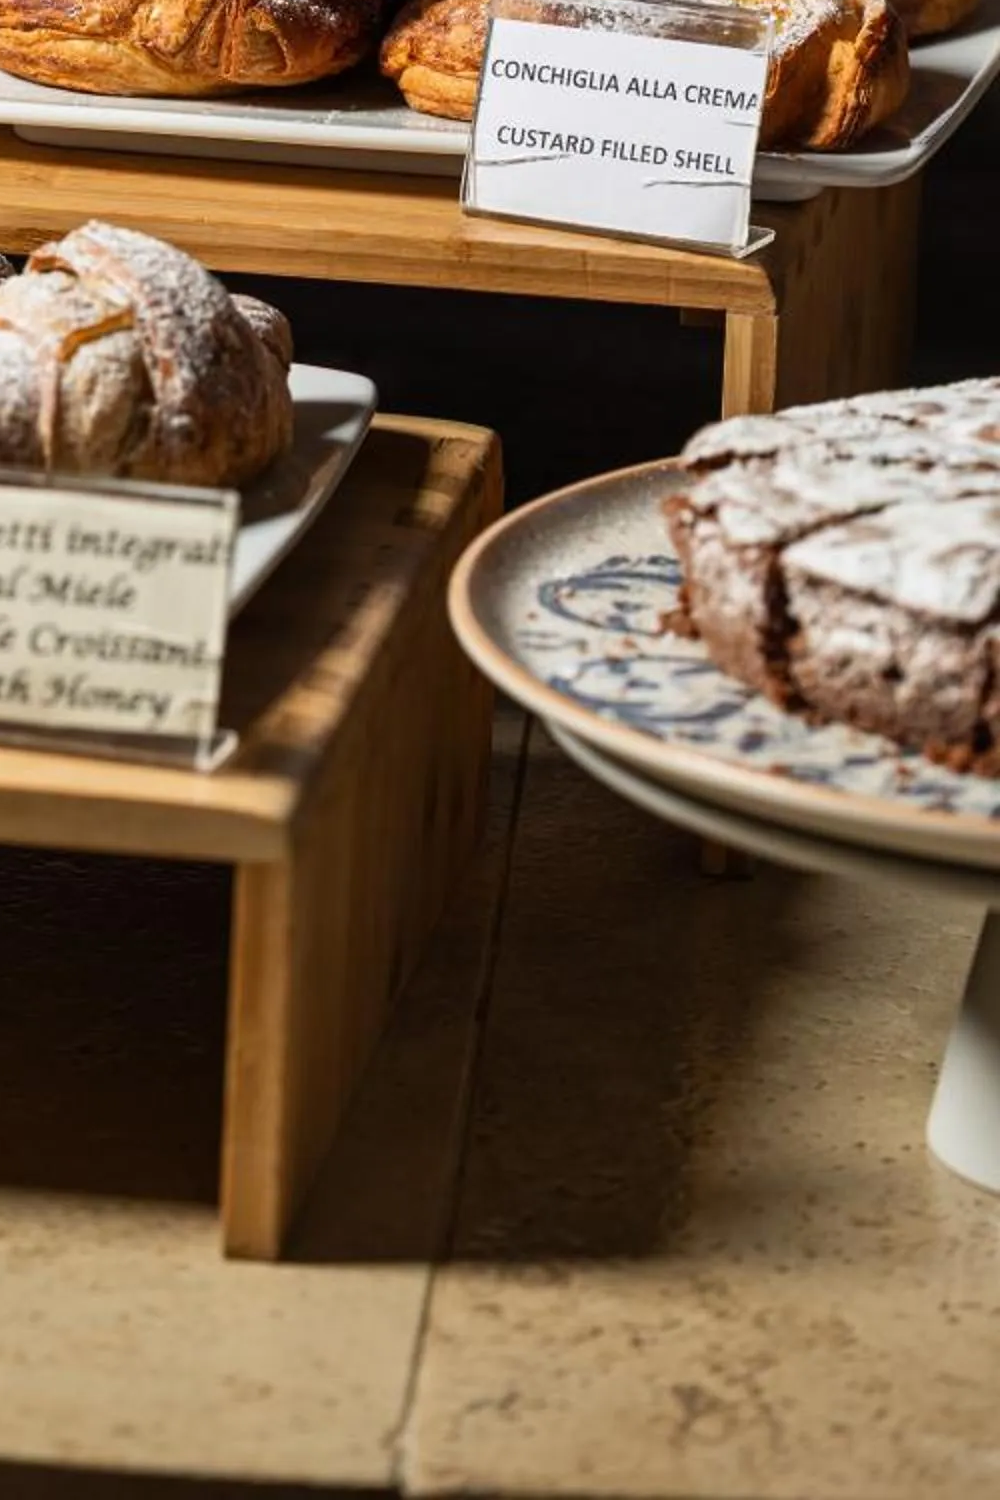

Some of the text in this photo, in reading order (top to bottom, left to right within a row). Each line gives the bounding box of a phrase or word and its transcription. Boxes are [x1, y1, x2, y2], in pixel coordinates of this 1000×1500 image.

[491, 58, 757, 112] CONCHIGLIA ALLA CREMA
[497, 124, 736, 176] CUSTARD FILLED SHELL
[66, 525, 231, 574] integral
